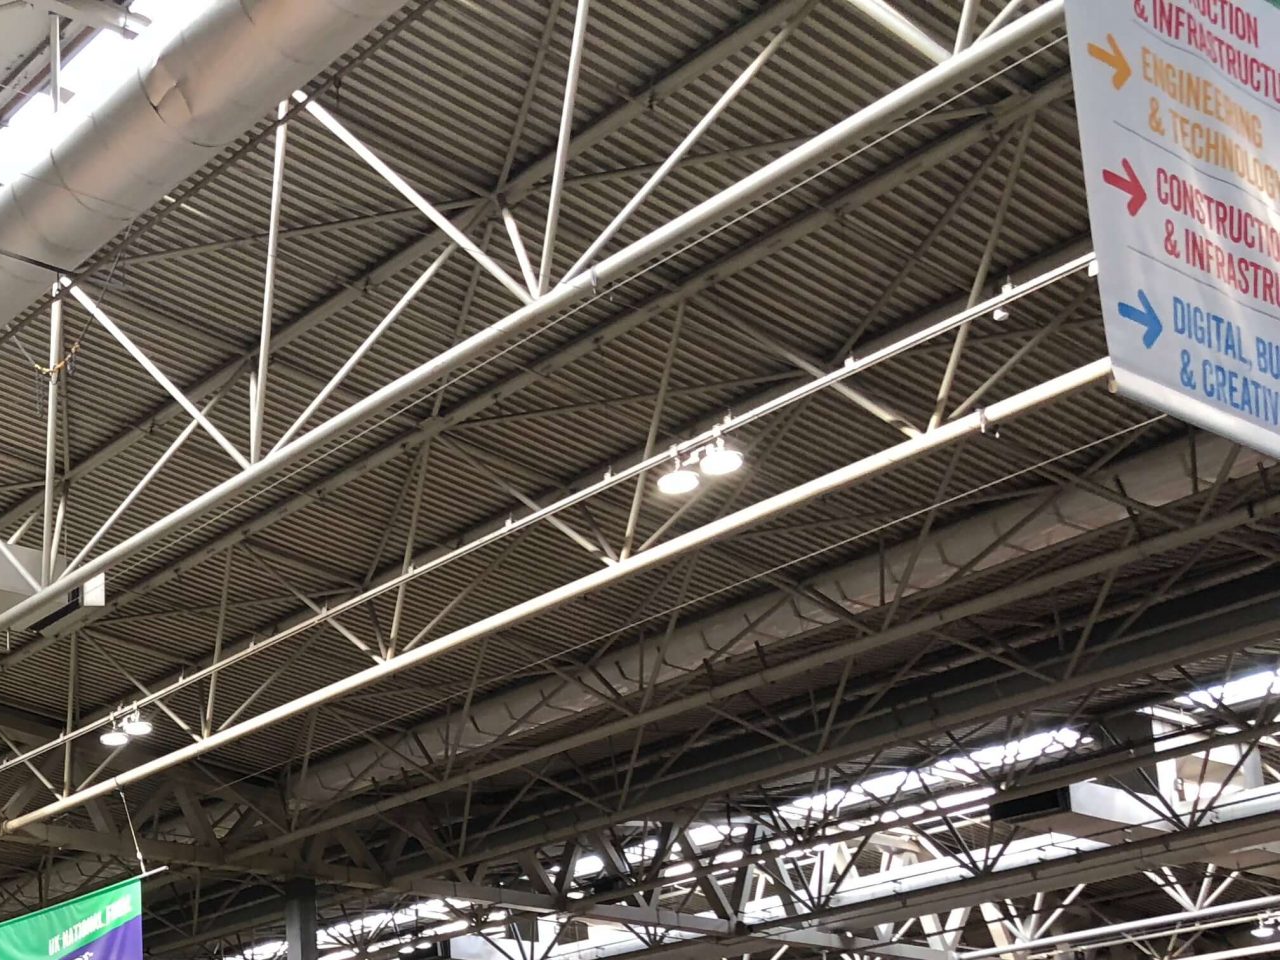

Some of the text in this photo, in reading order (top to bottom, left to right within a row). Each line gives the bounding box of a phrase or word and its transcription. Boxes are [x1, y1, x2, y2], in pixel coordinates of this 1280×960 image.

[1189, 0, 1258, 48] UCTION
[1141, 46, 1263, 148] ENGINEERING
[1149, 97, 1165, 136] &
[1164, 218, 1180, 259] &
[1173, 296, 1253, 371] DIGITAL,
[1180, 349, 1197, 391] &
